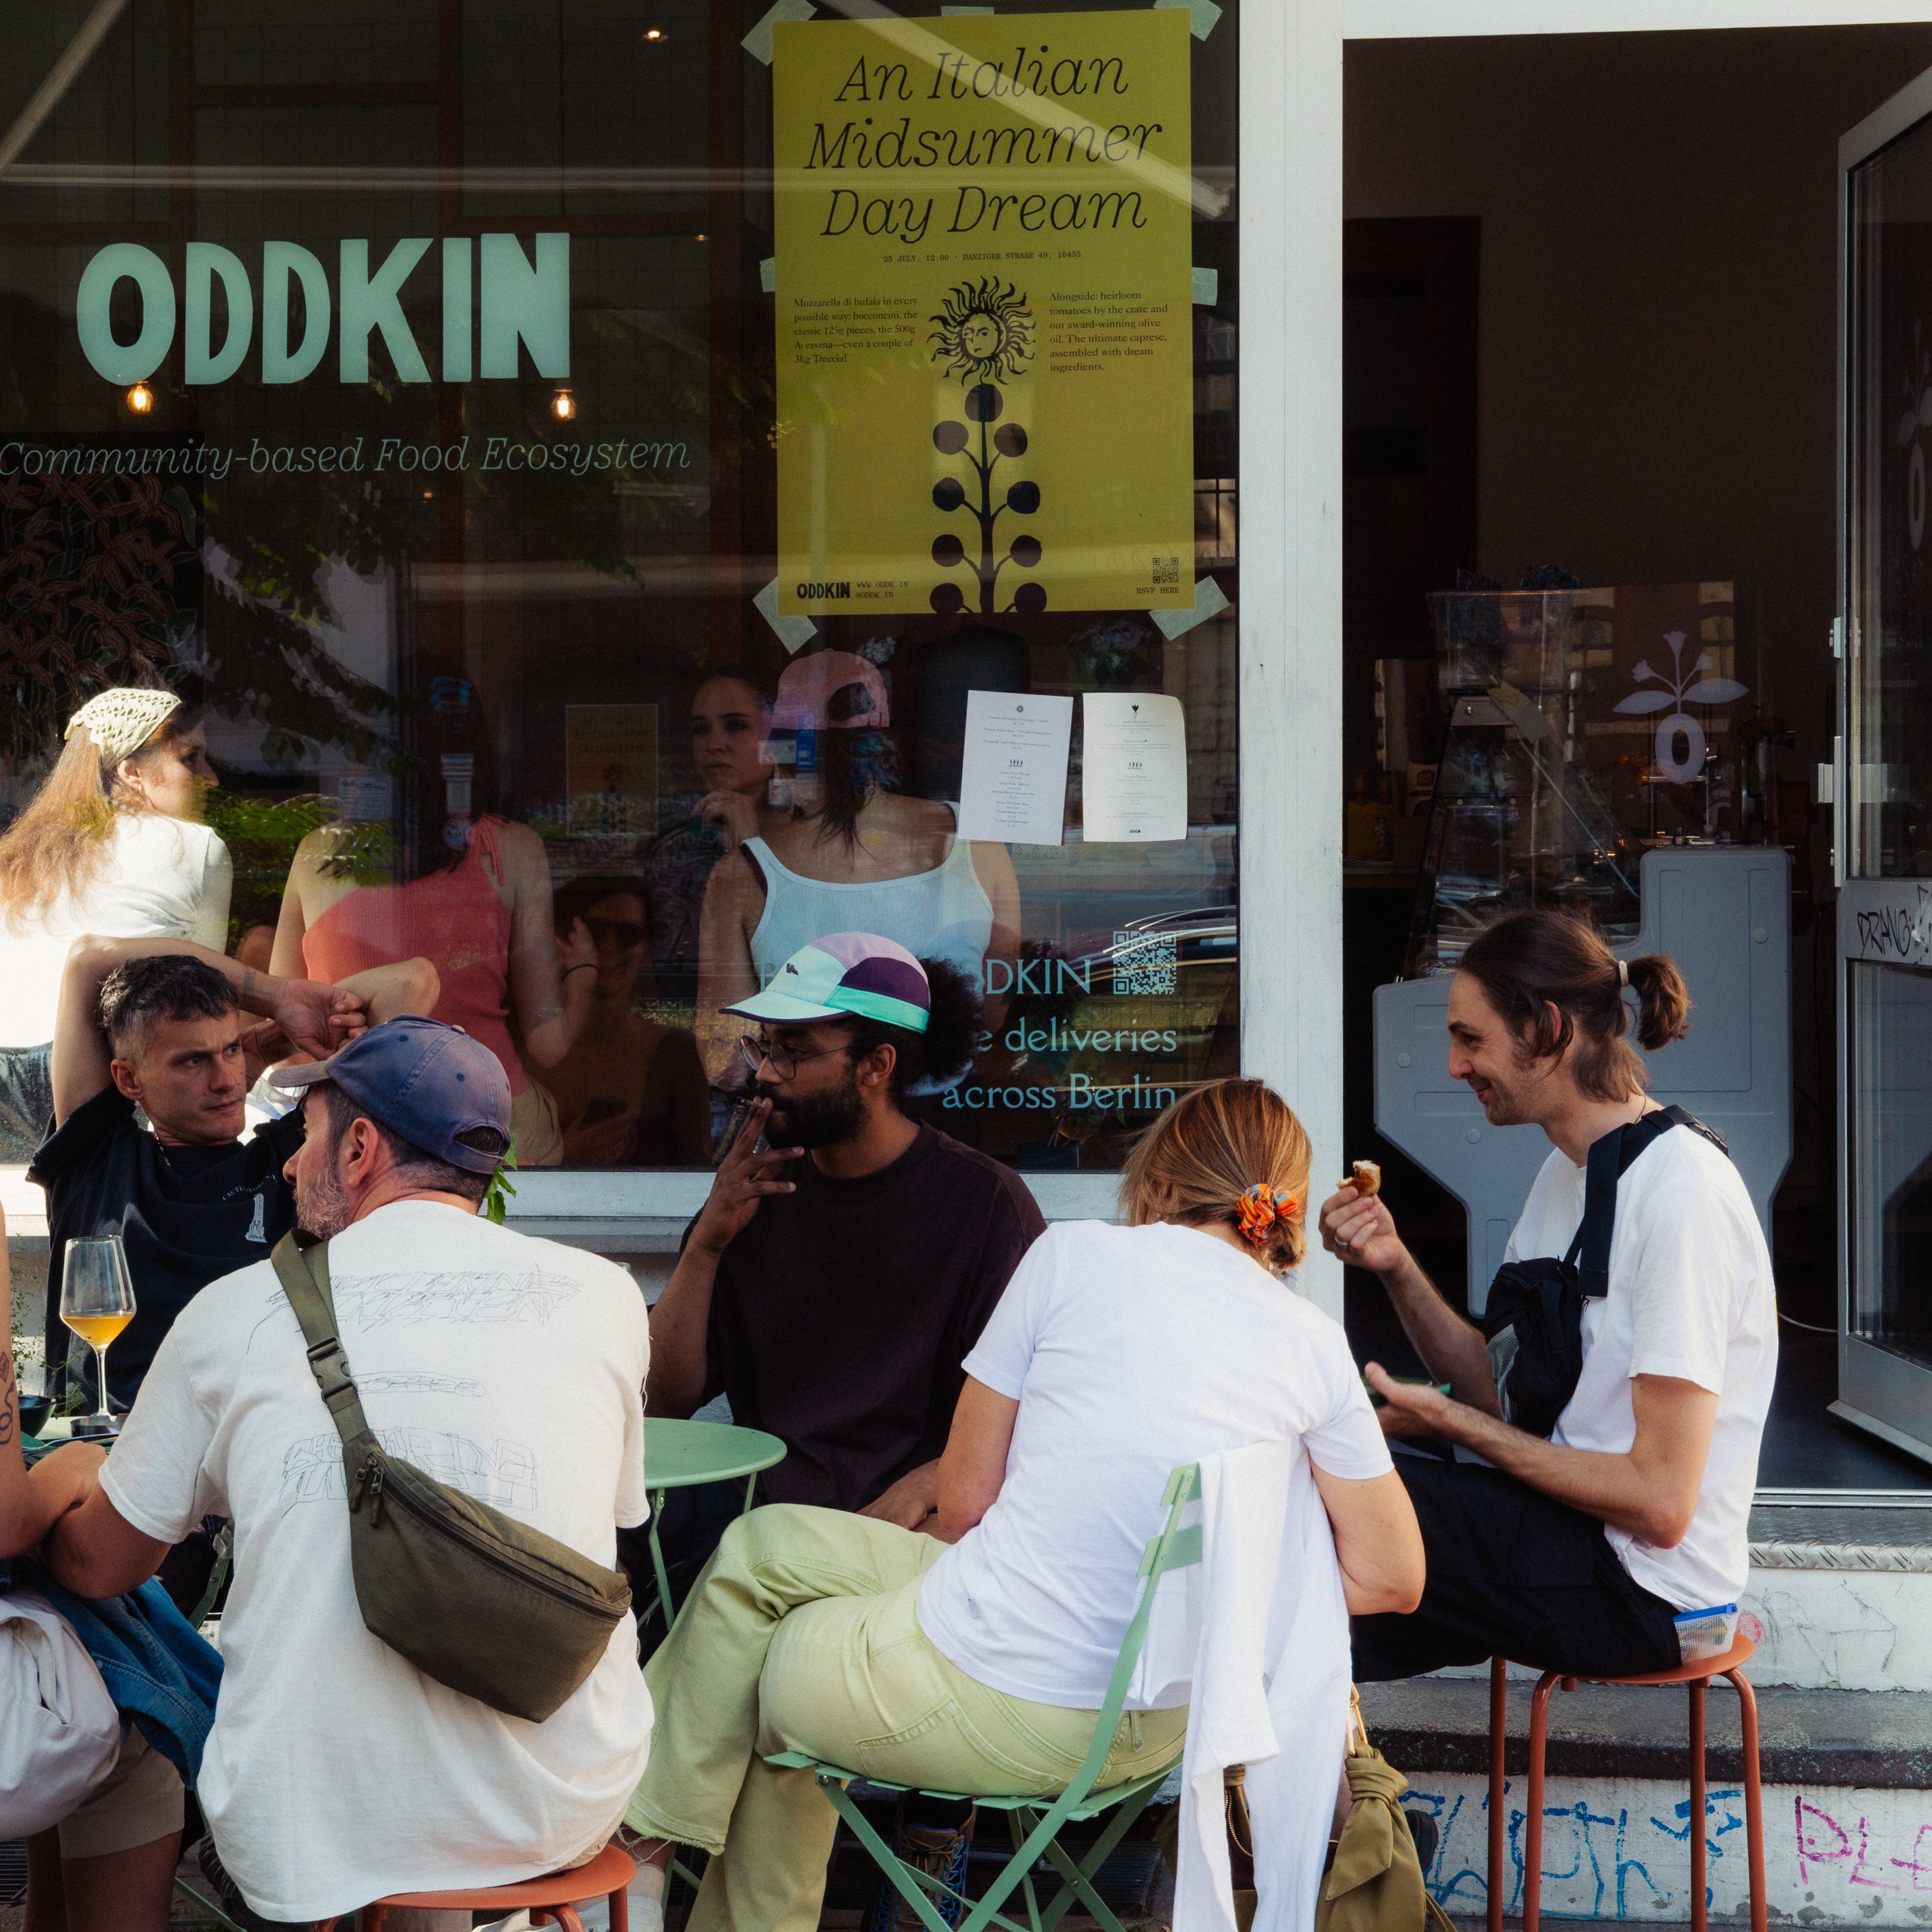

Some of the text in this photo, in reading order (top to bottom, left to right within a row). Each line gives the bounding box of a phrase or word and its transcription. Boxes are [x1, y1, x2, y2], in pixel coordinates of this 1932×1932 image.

[834, 45, 1129, 102] An Italian
[804, 117, 1162, 170] Midsummer
[820, 186, 1147, 243] Day Dream
[897, 255, 920, 263] JULY,
[794, 297, 918, 307] Mozzarella di bufala in every
[1049, 291, 1141, 302] Alongside: heirloom
[76, 232, 570, 386] ODDKIN
[1050, 307, 1091, 315] tomatoes
[1094, 305, 1105, 316] by
[1108, 305, 1123, 314] the
[1150, 304, 1168, 313] and
[794, 310, 918, 323] possible way: bocconcini, the
[1067, 319, 1136, 329] award-winning
[1138, 318, 1161, 327] olive
[794, 324, 916, 336] classic 125g pieces, the 500g
[873, 339, 902, 349] couple
[905, 338, 914, 347] of
[1049, 334, 1167, 343] oil. The ultimate caprese,
[1050, 347, 1153, 357] assembled with dream
[794, 354, 847, 365] 3kg Treccia!
[1050, 362, 1104, 373] ingredients.
[0, 437, 691, 479] Community-based Food Ecosystem
[797, 582, 850, 599] ODDKIN
[986, 959, 1090, 995] DKIN
[1005, 1017, 1177, 1051] deliveries
[942, 1074, 1176, 1109] across Berlin
